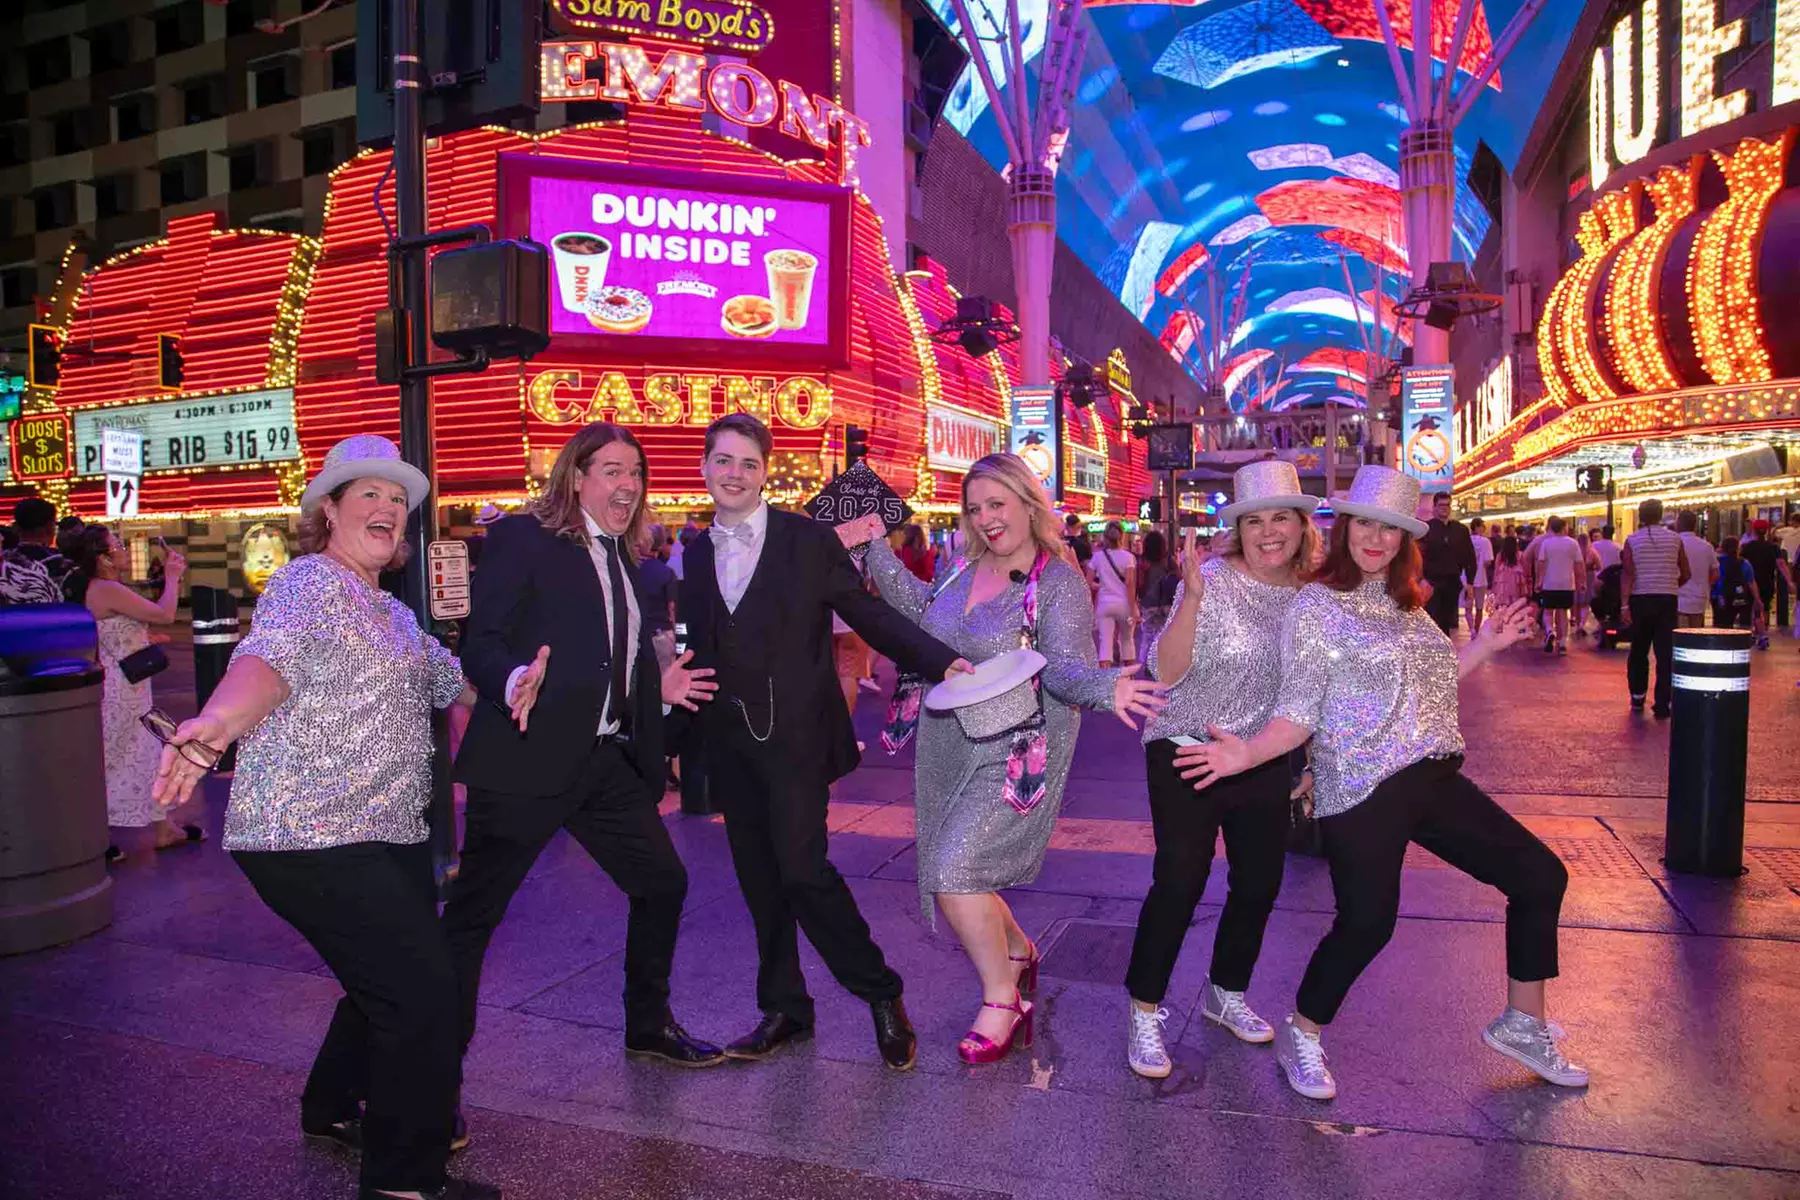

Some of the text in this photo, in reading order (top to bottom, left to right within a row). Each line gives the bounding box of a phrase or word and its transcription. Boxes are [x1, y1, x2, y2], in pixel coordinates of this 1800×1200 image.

[656, 0, 761, 39] Boyd's
[592, 193, 776, 236] DUNKIN'
[620, 232, 750, 266] INSIDE
[528, 369, 833, 428] CASINO
[20, 420, 63, 443] LOOSE
[168, 435, 206, 465] RIB
[224, 426, 290, 462] $15.99
[23, 452, 63, 475] SLOTS
[839, 482, 881, 497] Class of
[816, 496, 902, 523] 2025
